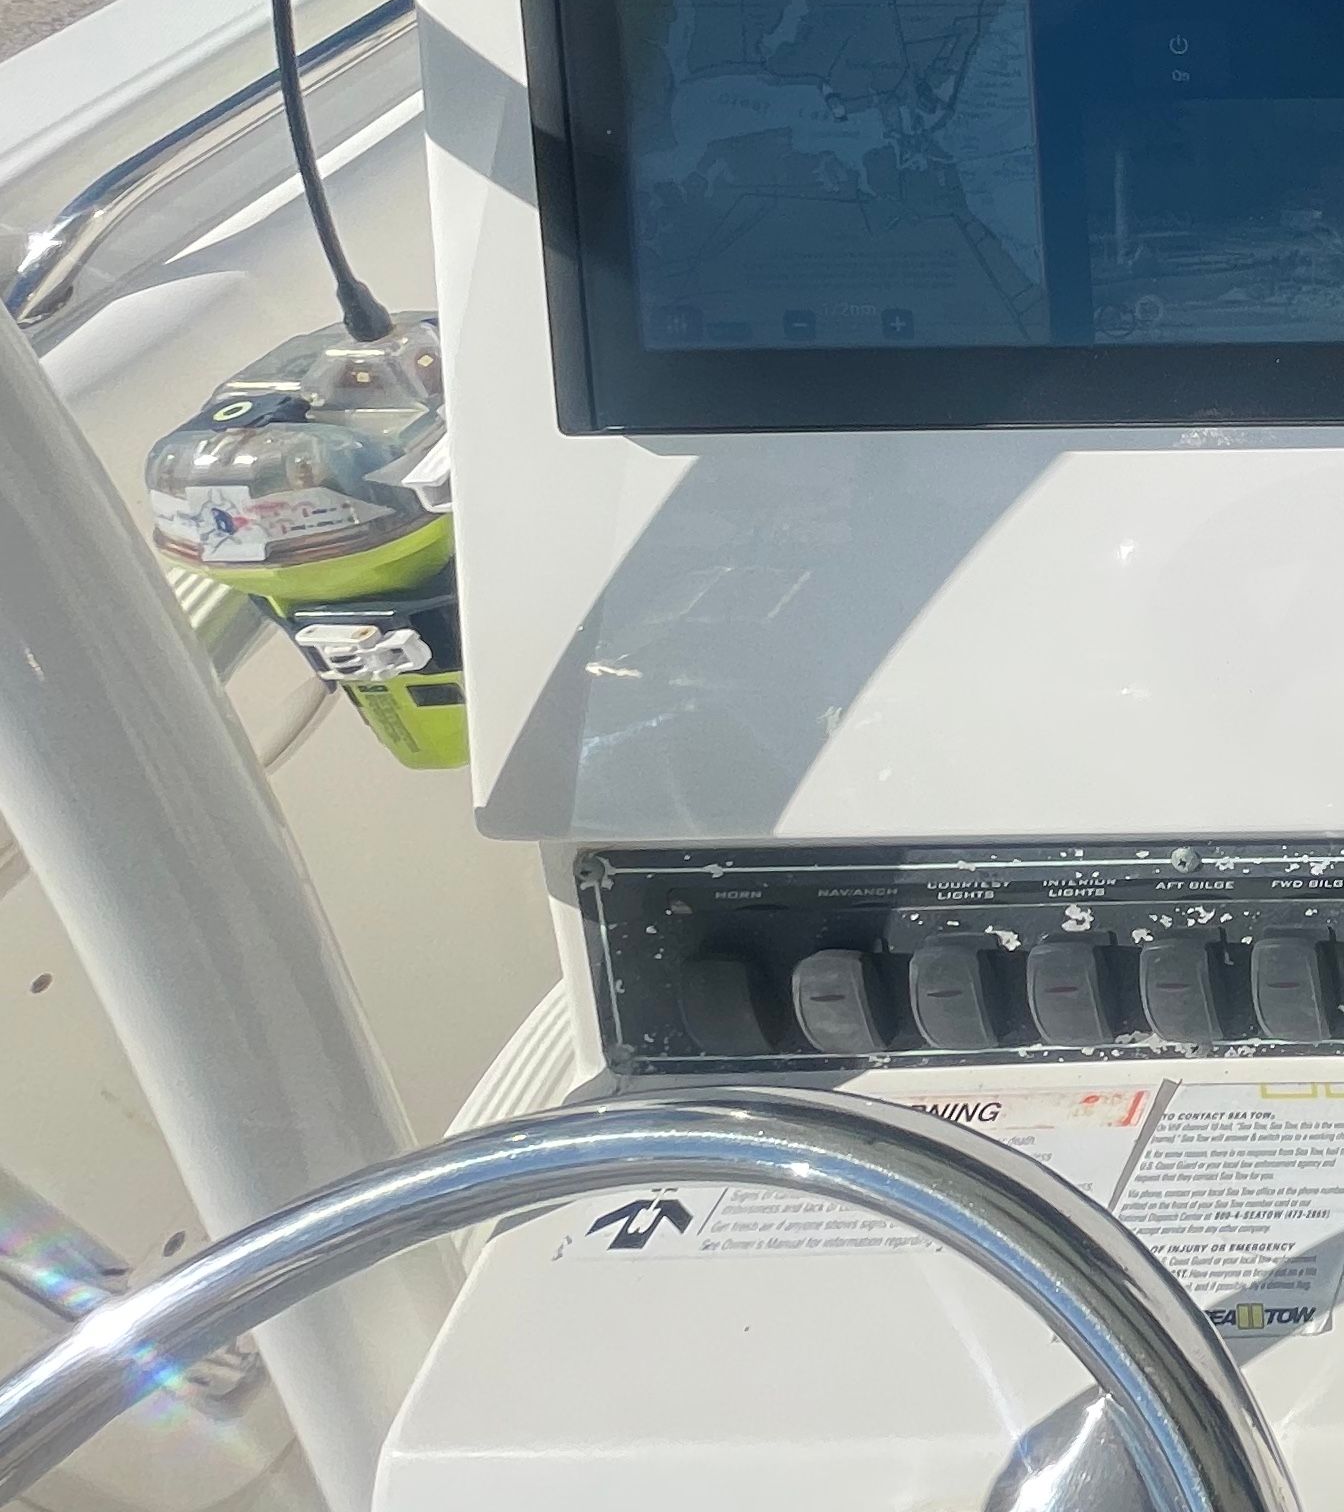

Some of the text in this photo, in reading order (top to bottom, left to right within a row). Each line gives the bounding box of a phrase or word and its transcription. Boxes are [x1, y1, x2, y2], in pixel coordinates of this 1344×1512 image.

[1155, 881, 1235, 890] AFT BILGE
[1271, 879, 1303, 888] FWD
[715, 891, 762, 899] HORN
[938, 890, 995, 900] LIGHTS
[1048, 888, 1105, 897] LIGHTS
[1177, 1112, 1225, 1120] CONTACT
[1228, 1112, 1248, 1120] SEA
[1166, 1244, 1208, 1254] INJURY
[1210, 1243, 1226, 1253] OR
[1229, 1242, 1296, 1252] EMERGENCY
